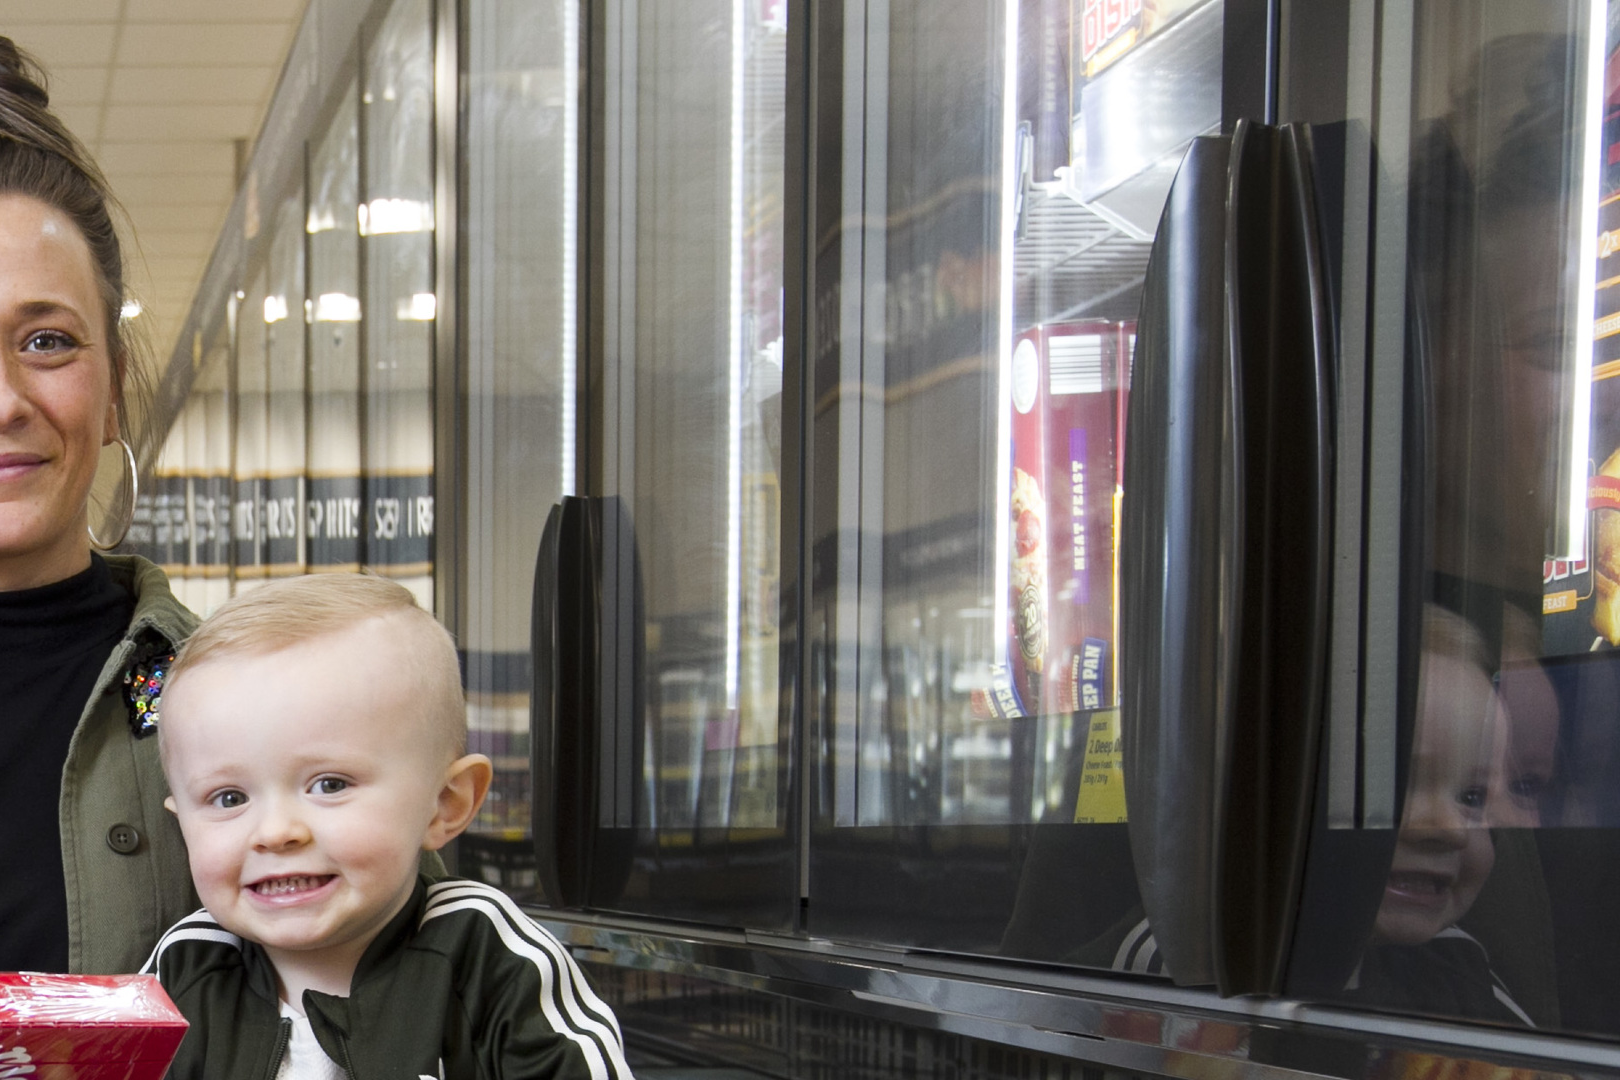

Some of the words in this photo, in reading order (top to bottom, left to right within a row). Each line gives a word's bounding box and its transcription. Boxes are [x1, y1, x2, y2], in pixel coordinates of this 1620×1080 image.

[1072, 460, 1085, 516] FEAST
[1073, 528, 1085, 571] MEAT
[1084, 644, 1102, 678] PAN
